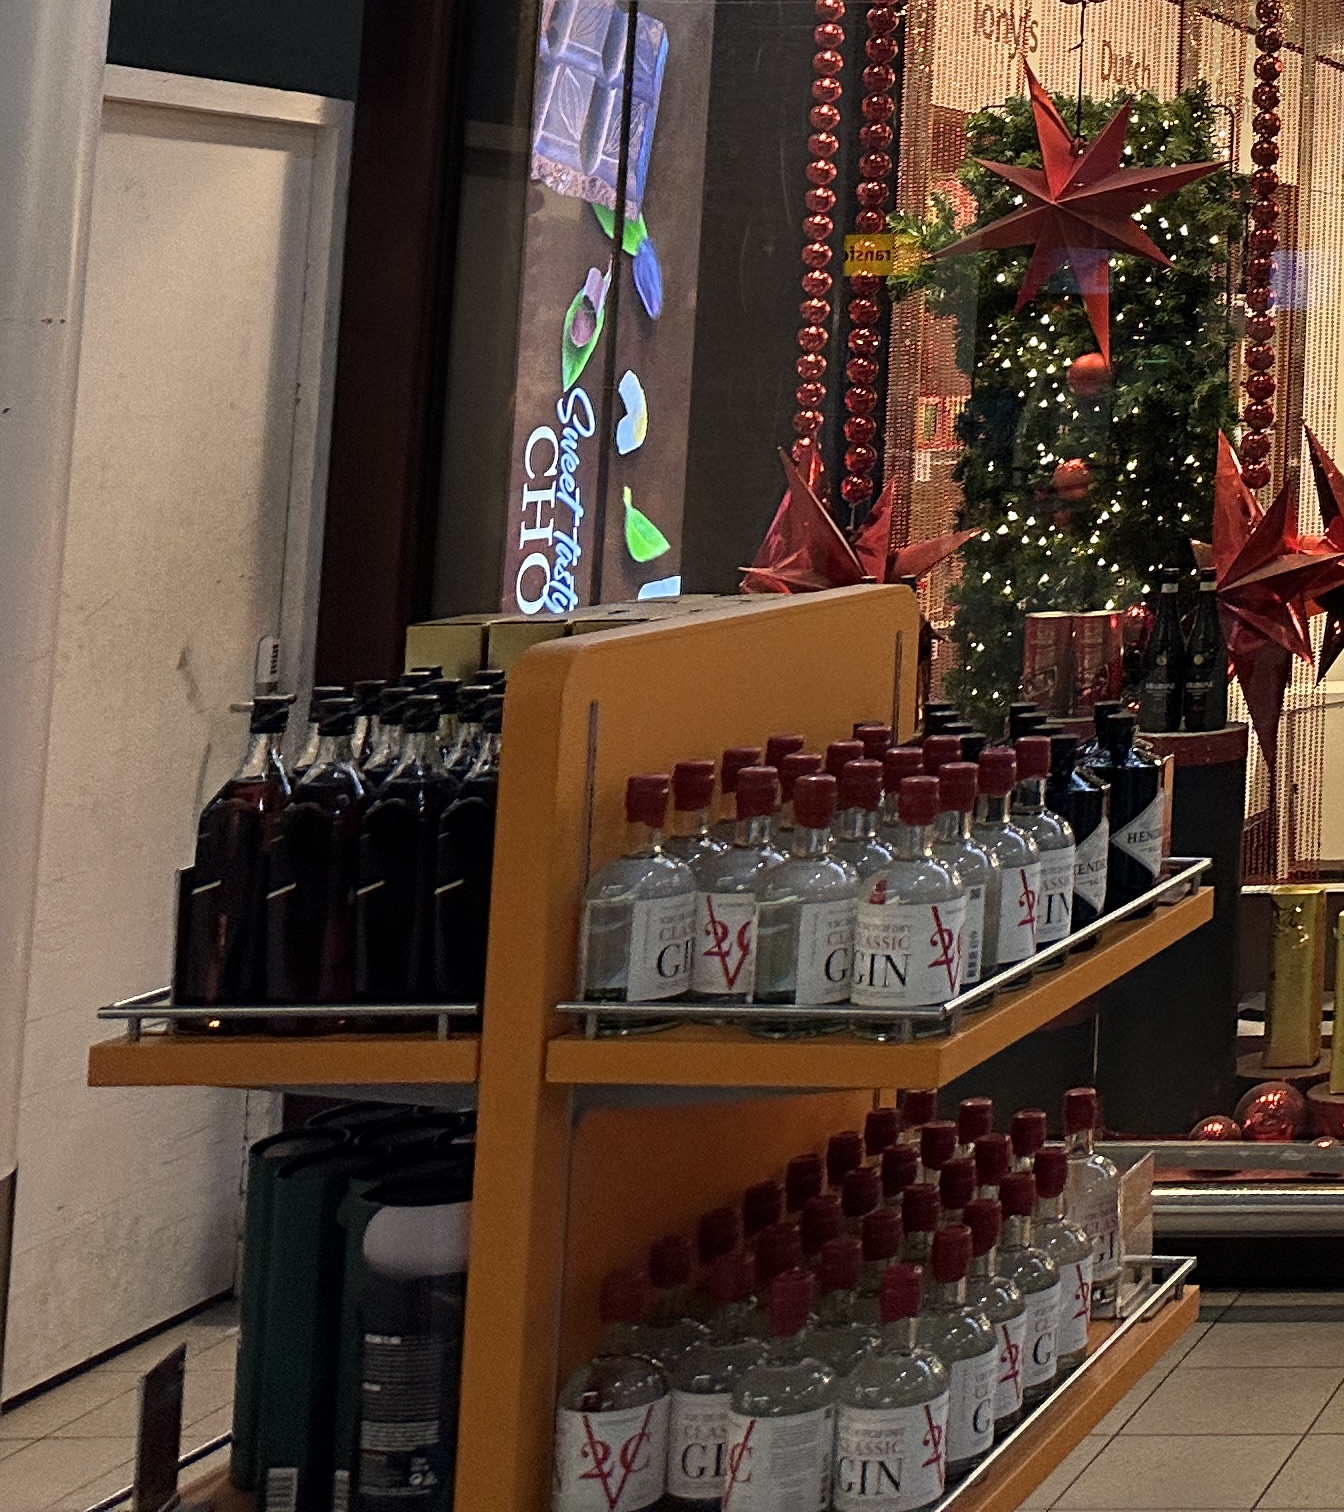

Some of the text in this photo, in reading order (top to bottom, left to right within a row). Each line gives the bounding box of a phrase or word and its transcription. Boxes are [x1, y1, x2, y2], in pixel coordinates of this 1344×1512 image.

[515, 425, 559, 615] CHO
[556, 387, 597, 527] Sweet
[681, 1441, 728, 1479] GI
